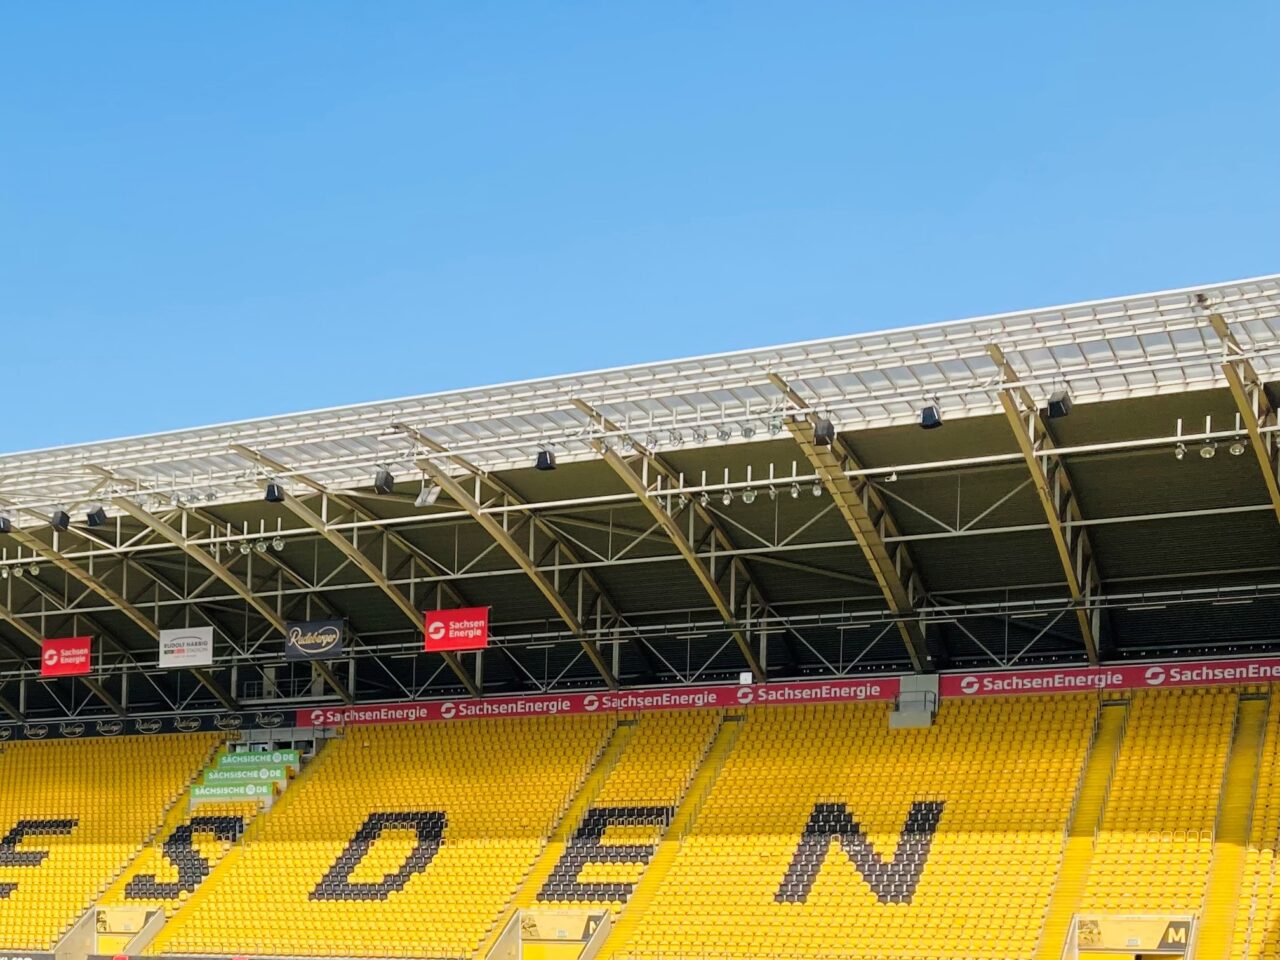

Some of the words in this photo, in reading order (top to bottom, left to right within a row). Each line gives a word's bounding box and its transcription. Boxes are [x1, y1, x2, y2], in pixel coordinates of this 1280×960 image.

[449, 620, 485, 629] Sachsen
[449, 628, 482, 638] Energie
[983, 671, 1123, 692] SachsenEnergie
[602, 692, 717, 708] SachsenEnergie
[757, 684, 880, 701] SachsenEnergie
[325, 706, 428, 723] SachsenEnergie
[458, 699, 571, 716] SachsenEnergie
[1167, 927, 1186, 944] M
